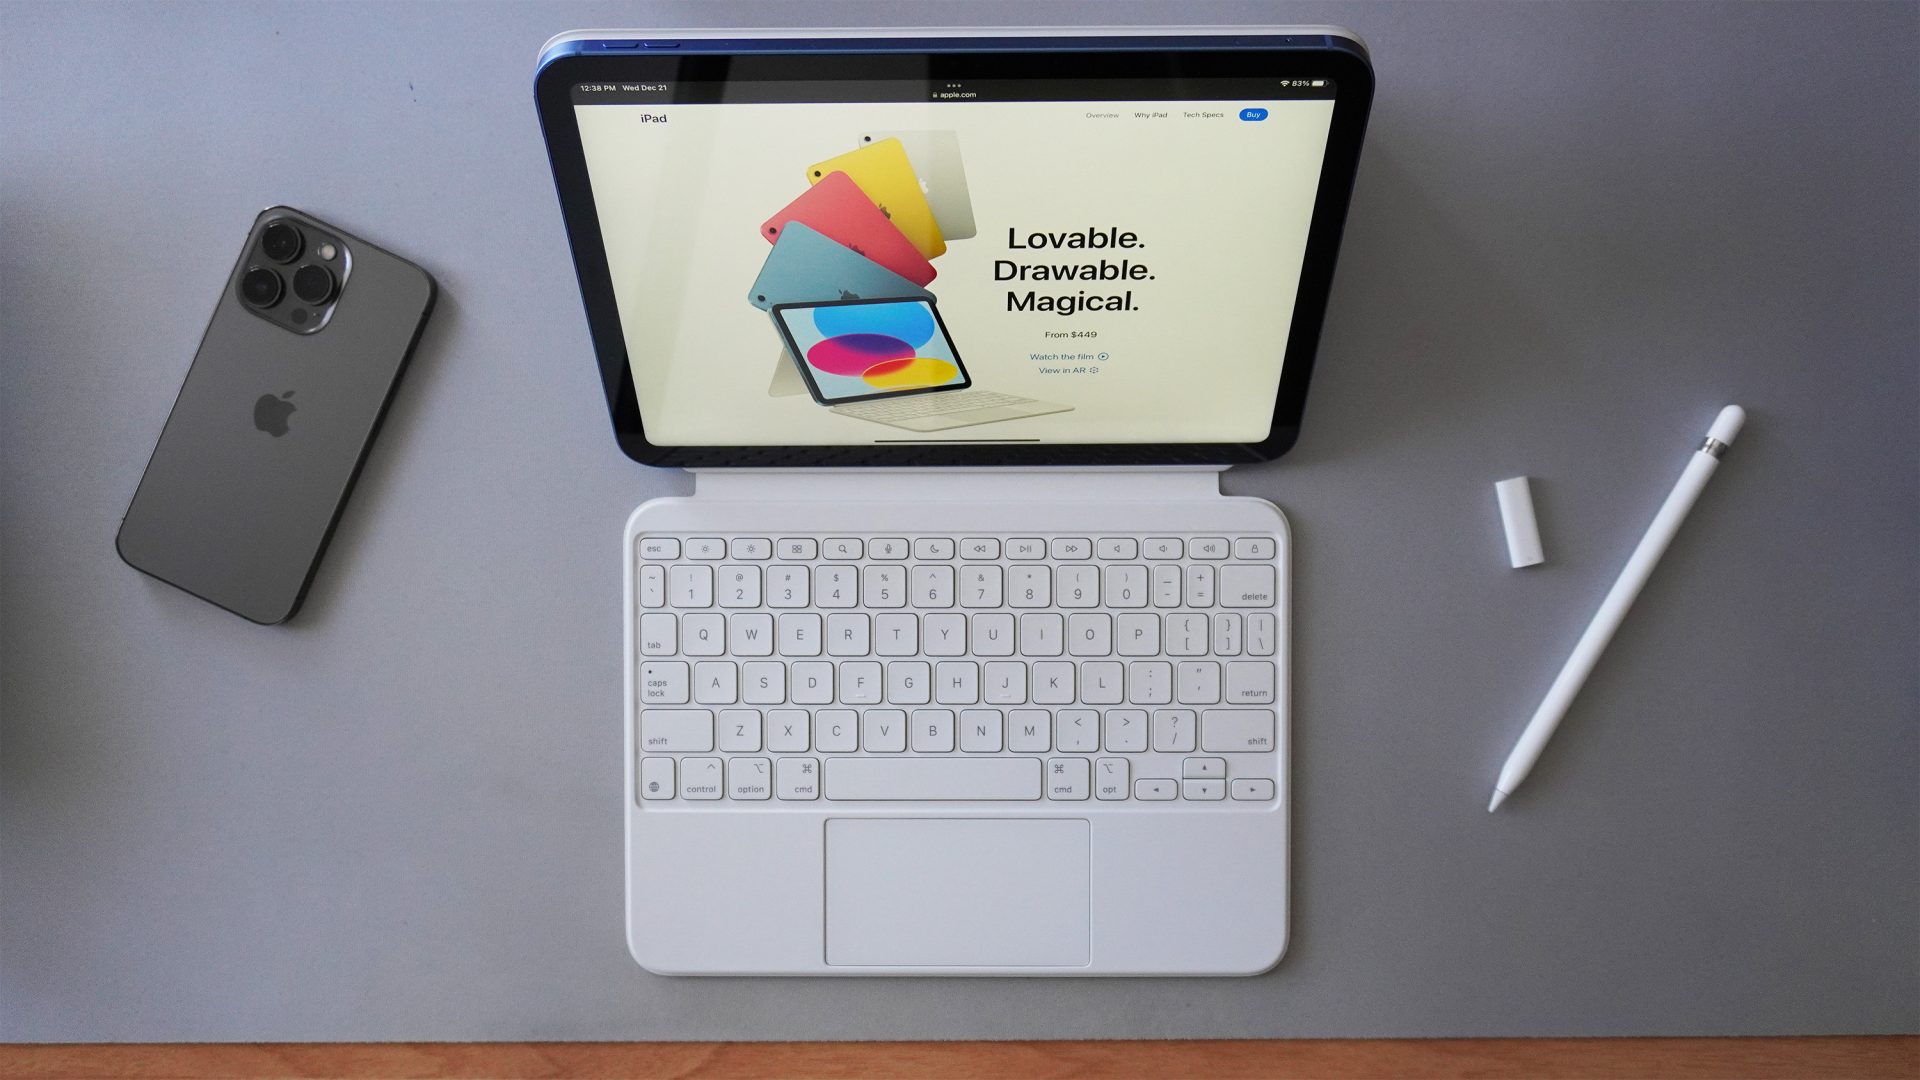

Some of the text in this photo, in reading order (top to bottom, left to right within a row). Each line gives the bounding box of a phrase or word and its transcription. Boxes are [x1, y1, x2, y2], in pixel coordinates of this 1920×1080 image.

[580, 84, 617, 93] 12:38 PM
[621, 84, 640, 92] Wed
[657, 84, 668, 92] 21
[940, 91, 977, 99] apple.com
[640, 113, 668, 123] iPad
[1201, 111, 1224, 119] Specs
[1246, 111, 1261, 120] Buy
[1008, 226, 1145, 250] Lovable.
[994, 259, 1156, 281] Drawable.
[1007, 290, 1139, 317] Magical.
[1044, 331, 1098, 339] From $449
[1029, 353, 1095, 361] Watch the film
[646, 545, 661, 553] esc
[688, 588, 694, 600] 1
[736, 588, 744, 600] 2
[784, 588, 792, 600] 3
[832, 588, 841, 600] 4
[881, 588, 889, 600] 5
[928, 588, 937, 600] 6
[977, 588, 985, 600] 7
[1025, 588, 1034, 600] 8
[1074, 588, 1082, 600] 9
[1122, 588, 1131, 600] 0
[1241, 593, 1268, 601] delete
[698, 628, 709, 641] Q
[745, 628, 758, 641] W
[796, 628, 804, 641] E
[844, 628, 853, 641] R
[892, 628, 901, 641] T
[940, 629, 950, 641] Y
[988, 628, 998, 641] U
[1085, 628, 1095, 641] O
[1134, 628, 1143, 640] P
[647, 641, 662, 649] tab
[647, 680, 668, 688] caps
[711, 676, 721, 689] A
[759, 676, 769, 689] S
[808, 677, 817, 689] D
[857, 676, 865, 688] F
[904, 676, 914, 689] G
[952, 677, 962, 689] H
[1001, 677, 1009, 689] J
[1049, 677, 1058, 689] K
[1099, 676, 1106, 689] L
[647, 689, 665, 697] lock
[1241, 689, 1268, 697] return
[736, 725, 744, 737] Z
[784, 725, 793, 737] X
[832, 725, 841, 737] C
[880, 725, 890, 737] V
[929, 725, 938, 737] B
[976, 725, 986, 737] N
[1024, 725, 1035, 737] M
[648, 737, 668, 745] shift
[1247, 737, 1267, 746] shift
[686, 785, 717, 793] control
[737, 785, 765, 794] option
[794, 785, 813, 793] cmd
[1054, 785, 1073, 794] cmd
[1102, 786, 1117, 794] opt
